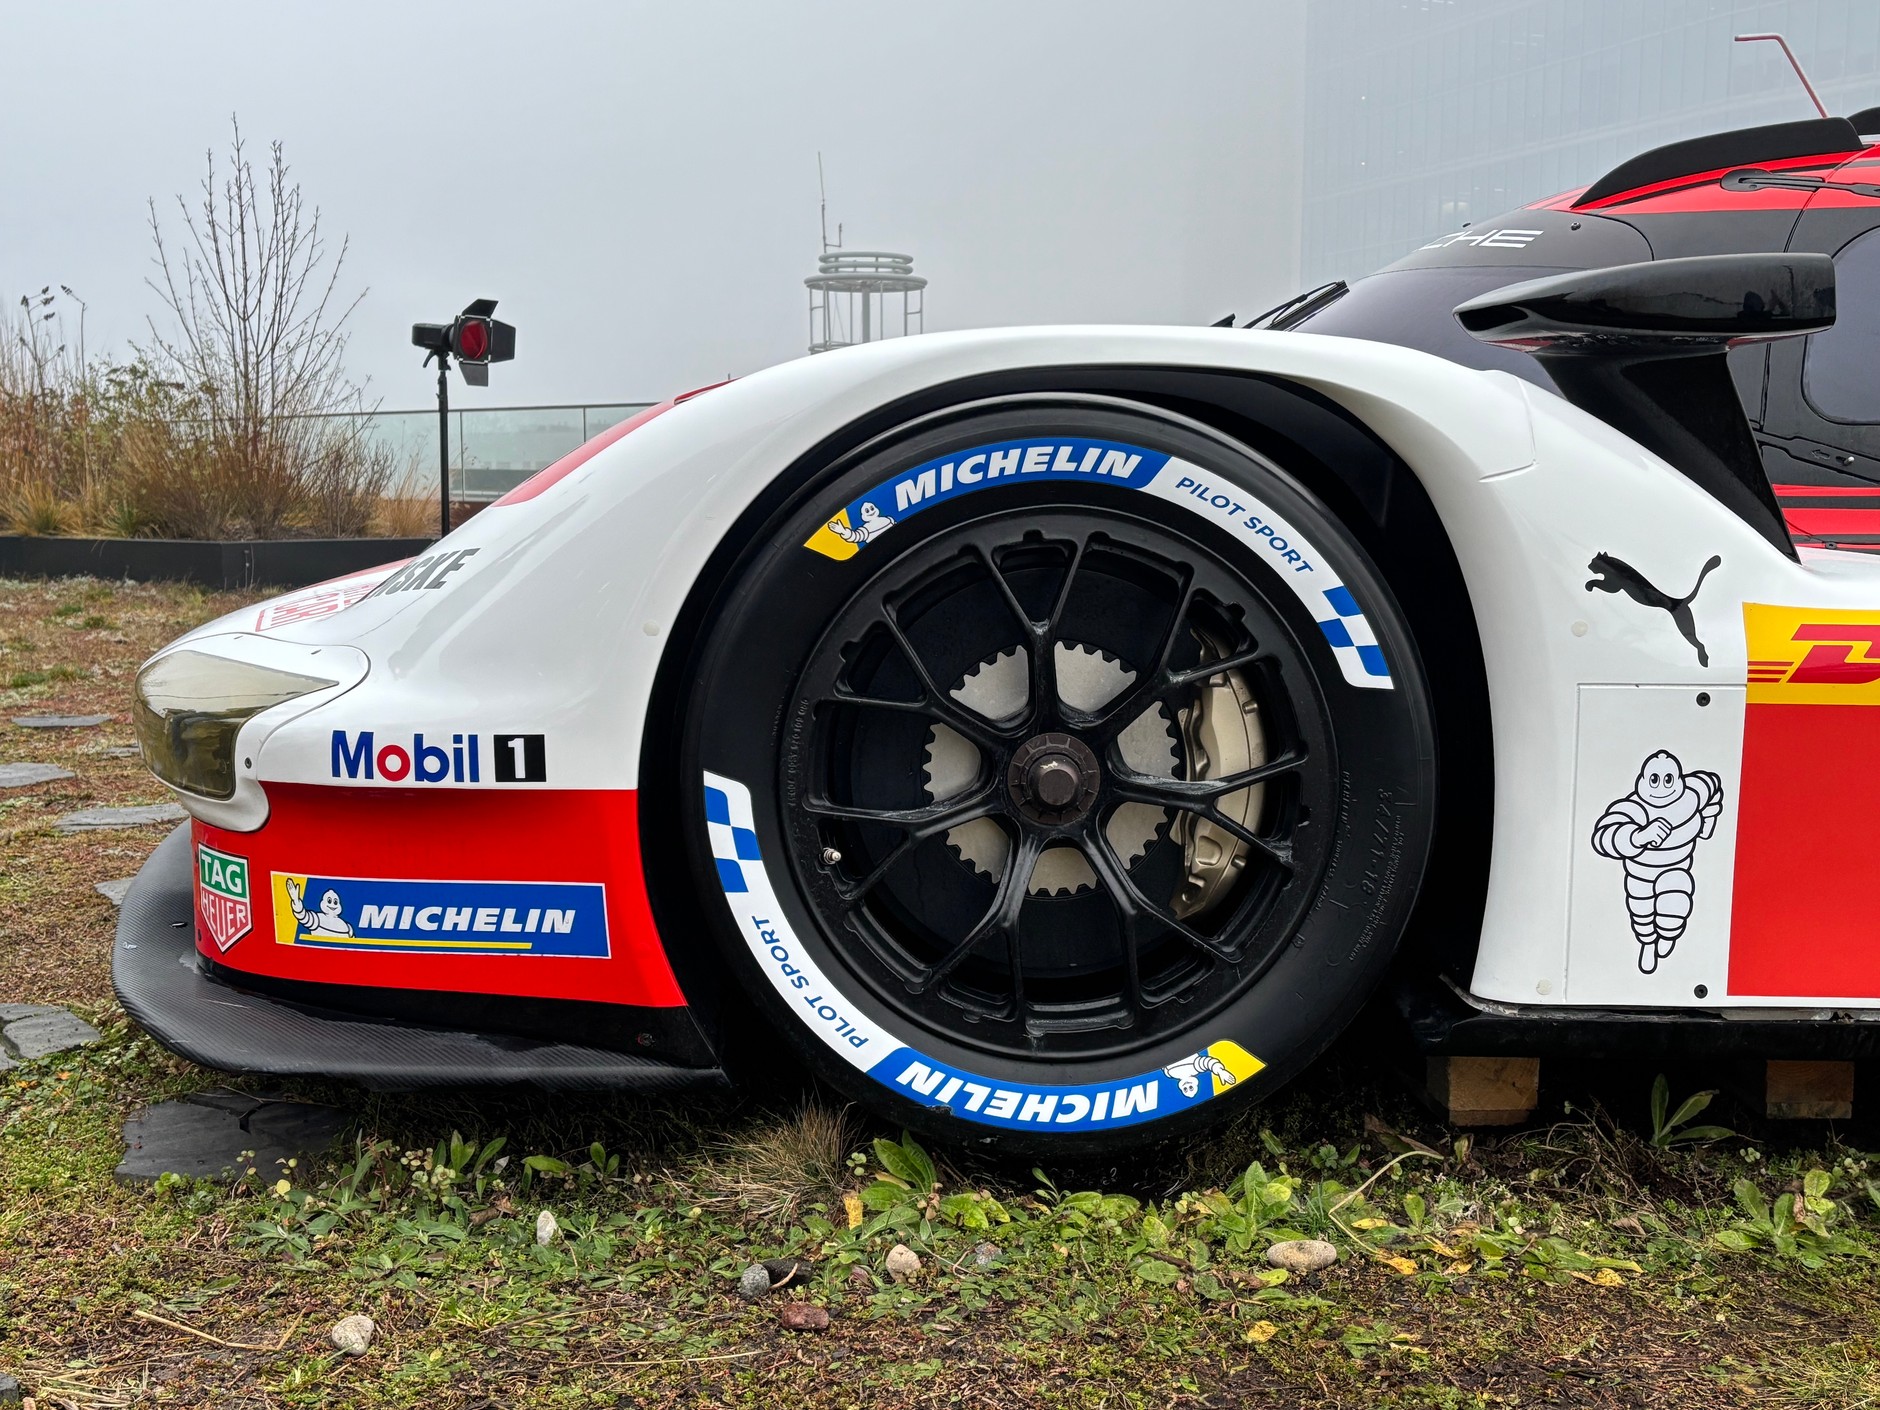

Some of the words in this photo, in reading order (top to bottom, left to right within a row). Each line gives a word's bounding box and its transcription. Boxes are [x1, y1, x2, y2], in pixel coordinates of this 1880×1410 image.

[895, 446, 1142, 512] MICHELIN
[1175, 477, 1246, 516] PILOT
[1243, 516, 1314, 573] SPORT
[331, 730, 480, 782] Mobil
[201, 853, 243, 894] TAG
[201, 890, 247, 943] HEUER
[358, 904, 576, 934] MICHELIN
[751, 915, 810, 989] SPORT
[803, 995, 870, 1049] PILOT
[895, 1060, 1159, 1124] MICHELIN
